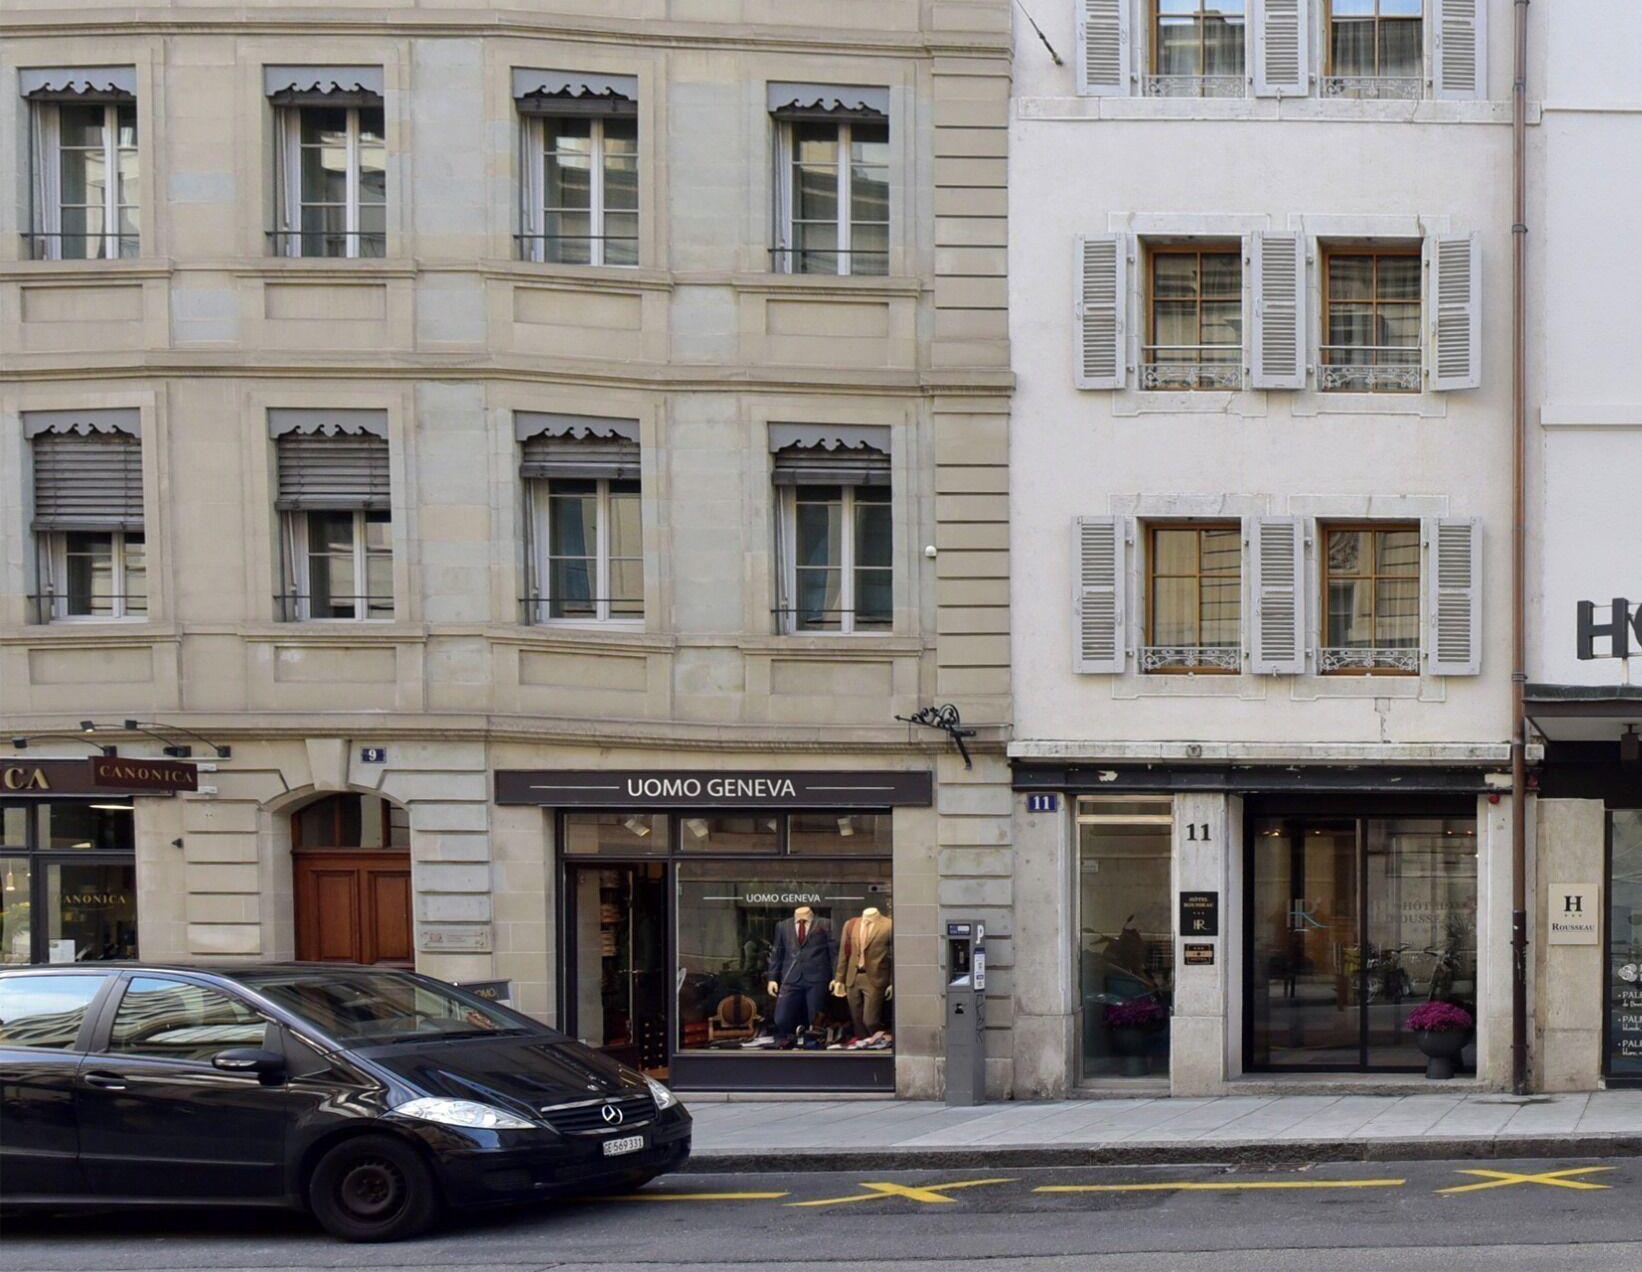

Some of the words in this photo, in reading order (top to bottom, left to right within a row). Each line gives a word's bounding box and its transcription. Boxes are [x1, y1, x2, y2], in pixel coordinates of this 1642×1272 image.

[368, 749, 377, 761] 9
[99, 765, 193, 783] CANONICA
[627, 778, 701, 797] UOMO
[707, 778, 796, 797] GENEVA
[1033, 795, 1050, 810] 11
[1186, 823, 1212, 841] 11
[746, 893, 779, 903] UOMO
[781, 893, 821, 903] GENEVA
[1563, 895, 1583, 912] H
[975, 924, 984, 944] P
[1552, 922, 1594, 931] ROUSSEAU
